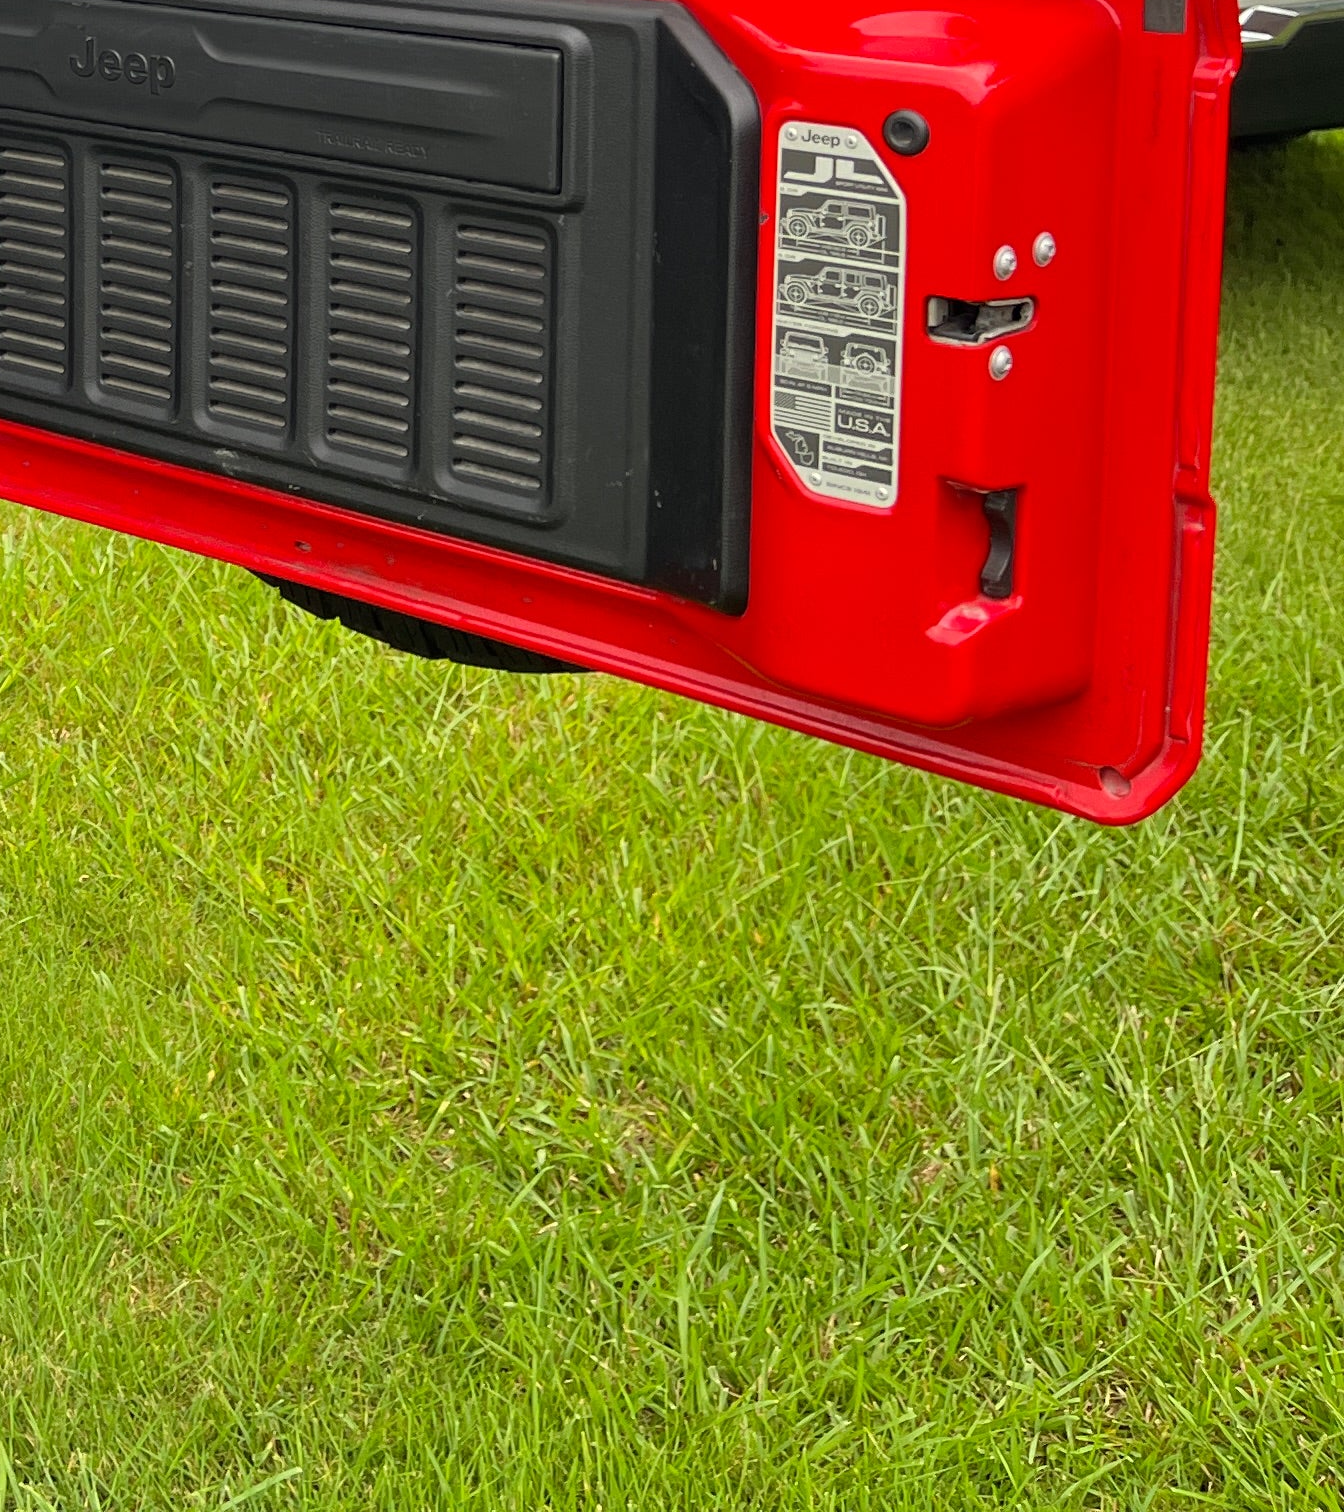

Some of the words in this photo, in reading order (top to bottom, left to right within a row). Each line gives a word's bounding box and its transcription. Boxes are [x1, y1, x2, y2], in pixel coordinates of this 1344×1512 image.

[69, 35, 177, 95] Jeep
[801, 129, 841, 148] Jeep
[783, 156, 884, 185] JL
[837, 414, 891, 437] U.S.A.
